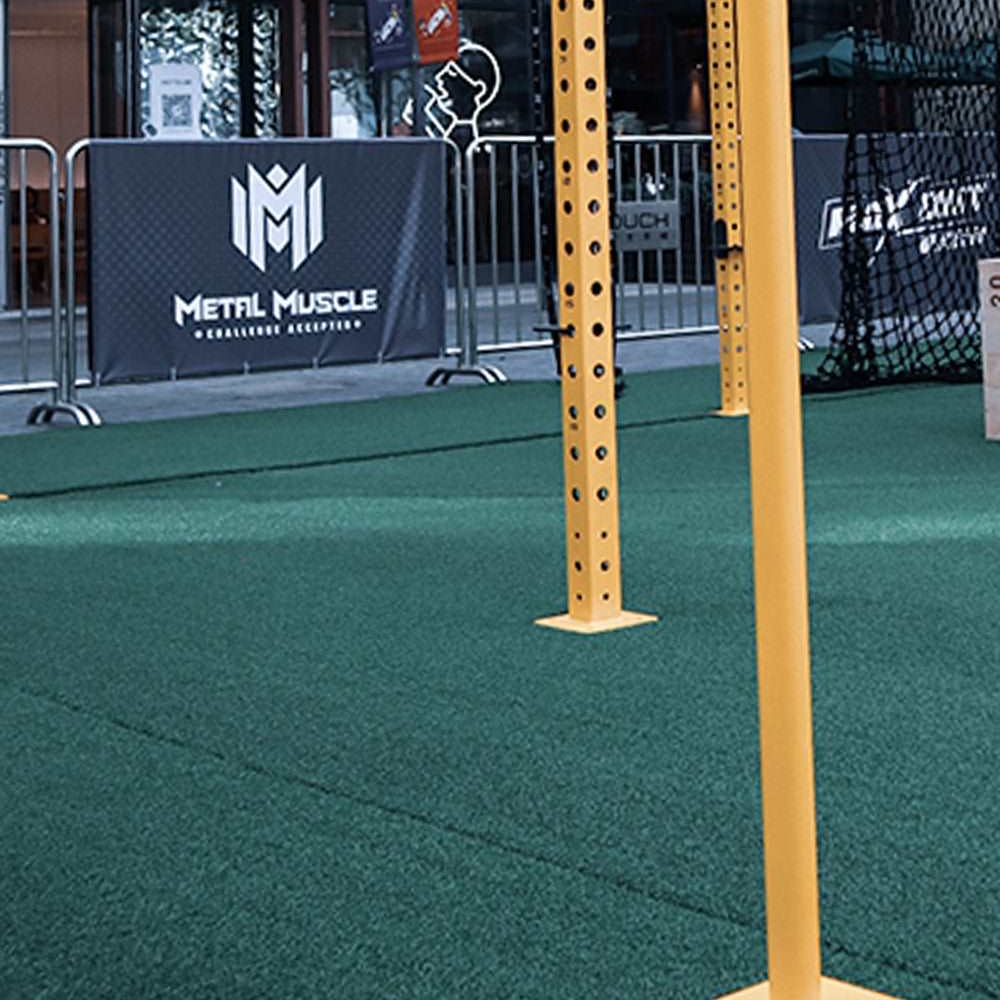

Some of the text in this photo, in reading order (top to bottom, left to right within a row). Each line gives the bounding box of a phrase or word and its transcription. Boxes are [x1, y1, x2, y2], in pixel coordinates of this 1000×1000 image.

[613, 211, 670, 230] OUCH
[174, 288, 378, 327] METAL MUSCLE
